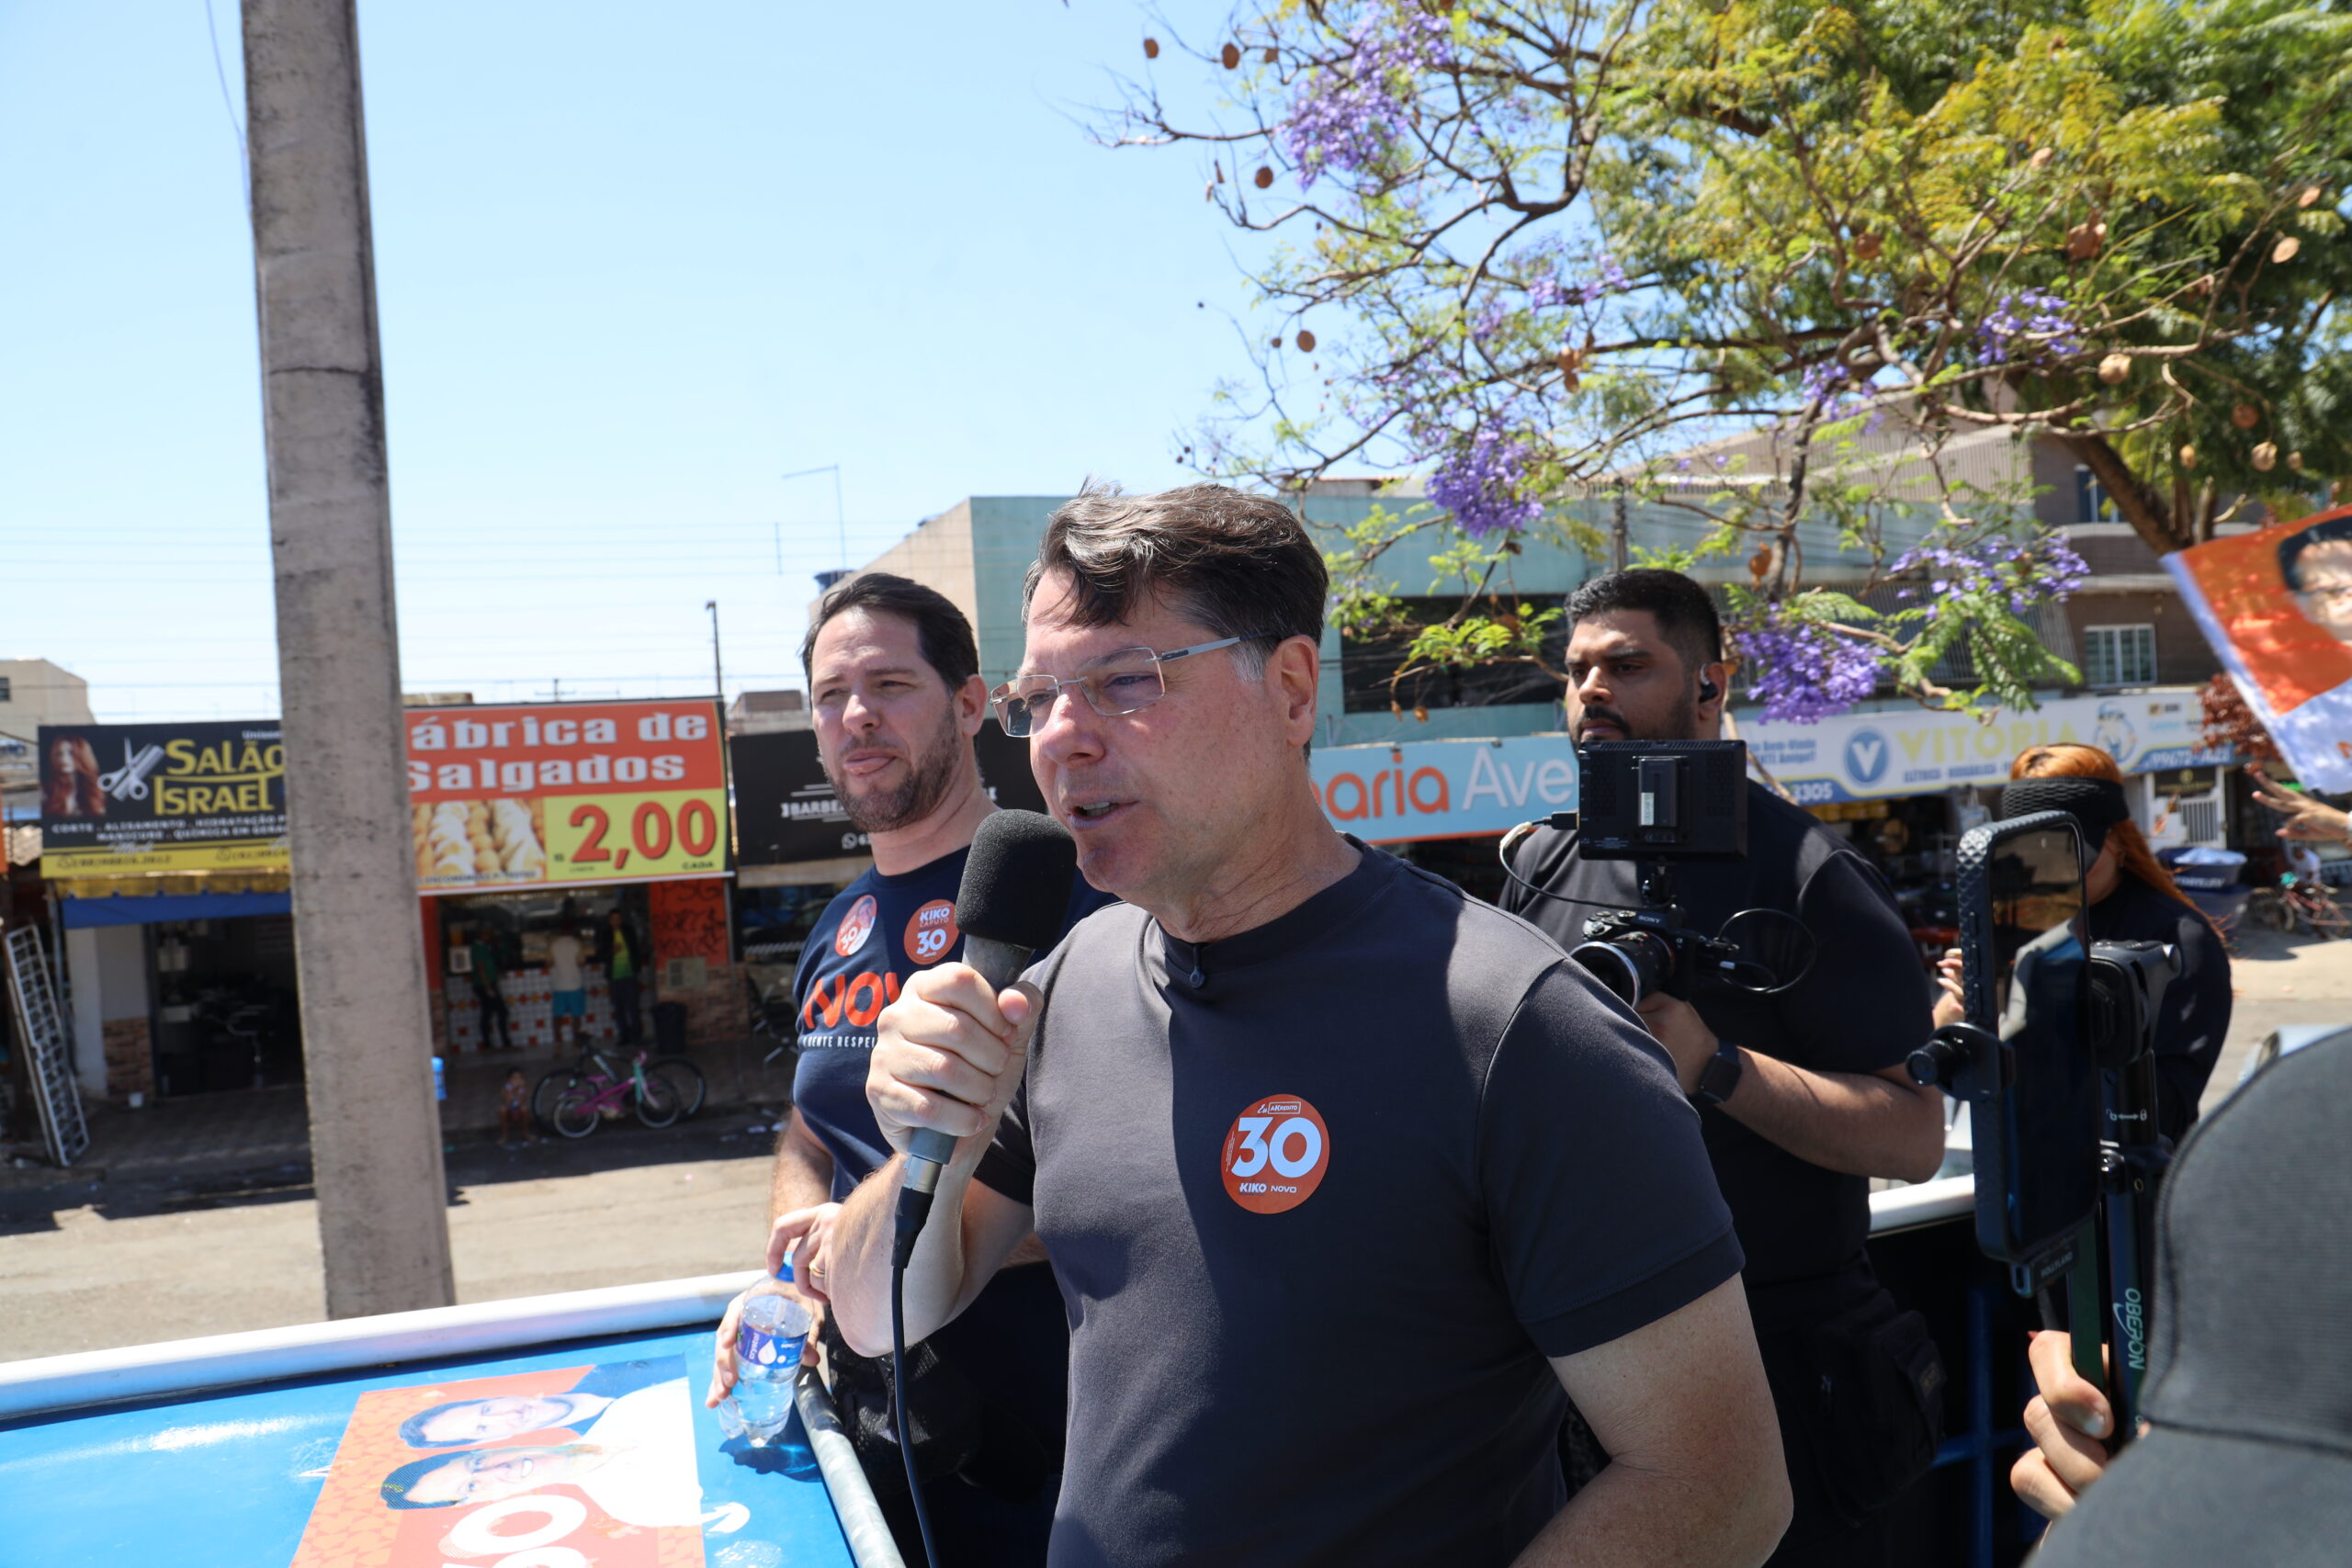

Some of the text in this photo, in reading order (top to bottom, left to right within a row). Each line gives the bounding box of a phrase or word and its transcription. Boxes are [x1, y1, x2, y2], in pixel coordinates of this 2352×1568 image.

[637, 710, 709, 742] de
[407, 754, 685, 792] Salgados
[1461, 746, 1576, 810] Ave
[1851, 740, 1883, 779] V
[153, 775, 274, 816] ISRAEL
[568, 799, 718, 870] 2,00
[919, 907, 951, 922] KIKO
[1638, 915, 1662, 924] SONY
[916, 929, 947, 955] 30
[1230, 1116, 1323, 1179] 30
[1238, 1182, 1297, 1194] KIKO NOVO
[2124, 1287, 2146, 1371] OBERON
